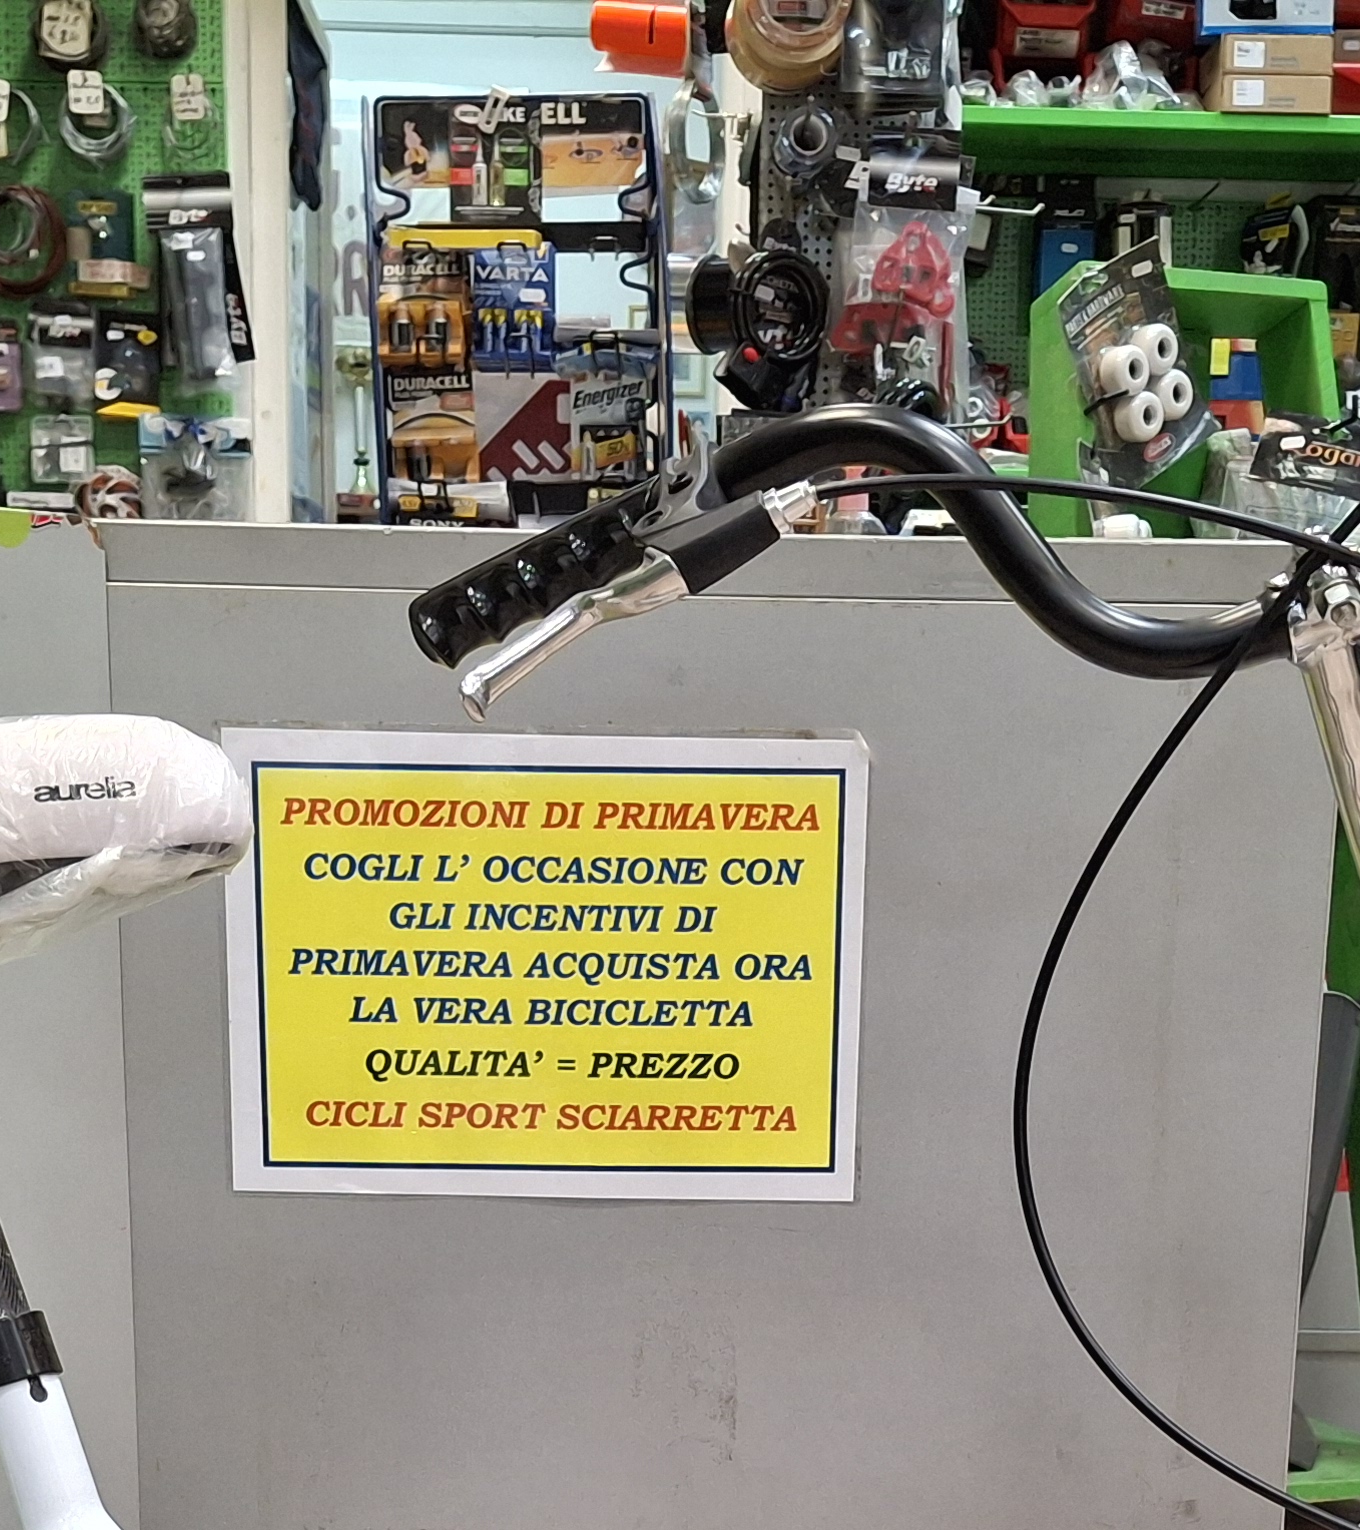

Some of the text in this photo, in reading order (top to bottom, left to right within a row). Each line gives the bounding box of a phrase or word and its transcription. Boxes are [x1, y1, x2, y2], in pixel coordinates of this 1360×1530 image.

[540, 102, 586, 127] ELL
[885, 173, 939, 194] Byte
[476, 265, 549, 282] VARTA
[393, 375, 471, 391] DURACELL
[572, 380, 644, 411] Energizer
[409, 518, 465, 528] SONY
[33, 776, 137, 804] aurelia
[280, 798, 821, 832] PROMOZIONI DI PRIMAVERA
[304, 854, 422, 882] COGLI
[483, 857, 706, 885] OCCASIONE
[720, 859, 803, 886] CON
[389, 903, 717, 933] GLI INCENTIVI DI
[289, 949, 812, 984] PRIMAVERA ACQUISTA ORA
[349, 997, 753, 1027] LA VERA BICICLETTA
[557, 1059, 576, 1072] =
[588, 1053, 740, 1079] PREZZO
[306, 1102, 797, 1131] CICLI SPORT SCIARRETTA
